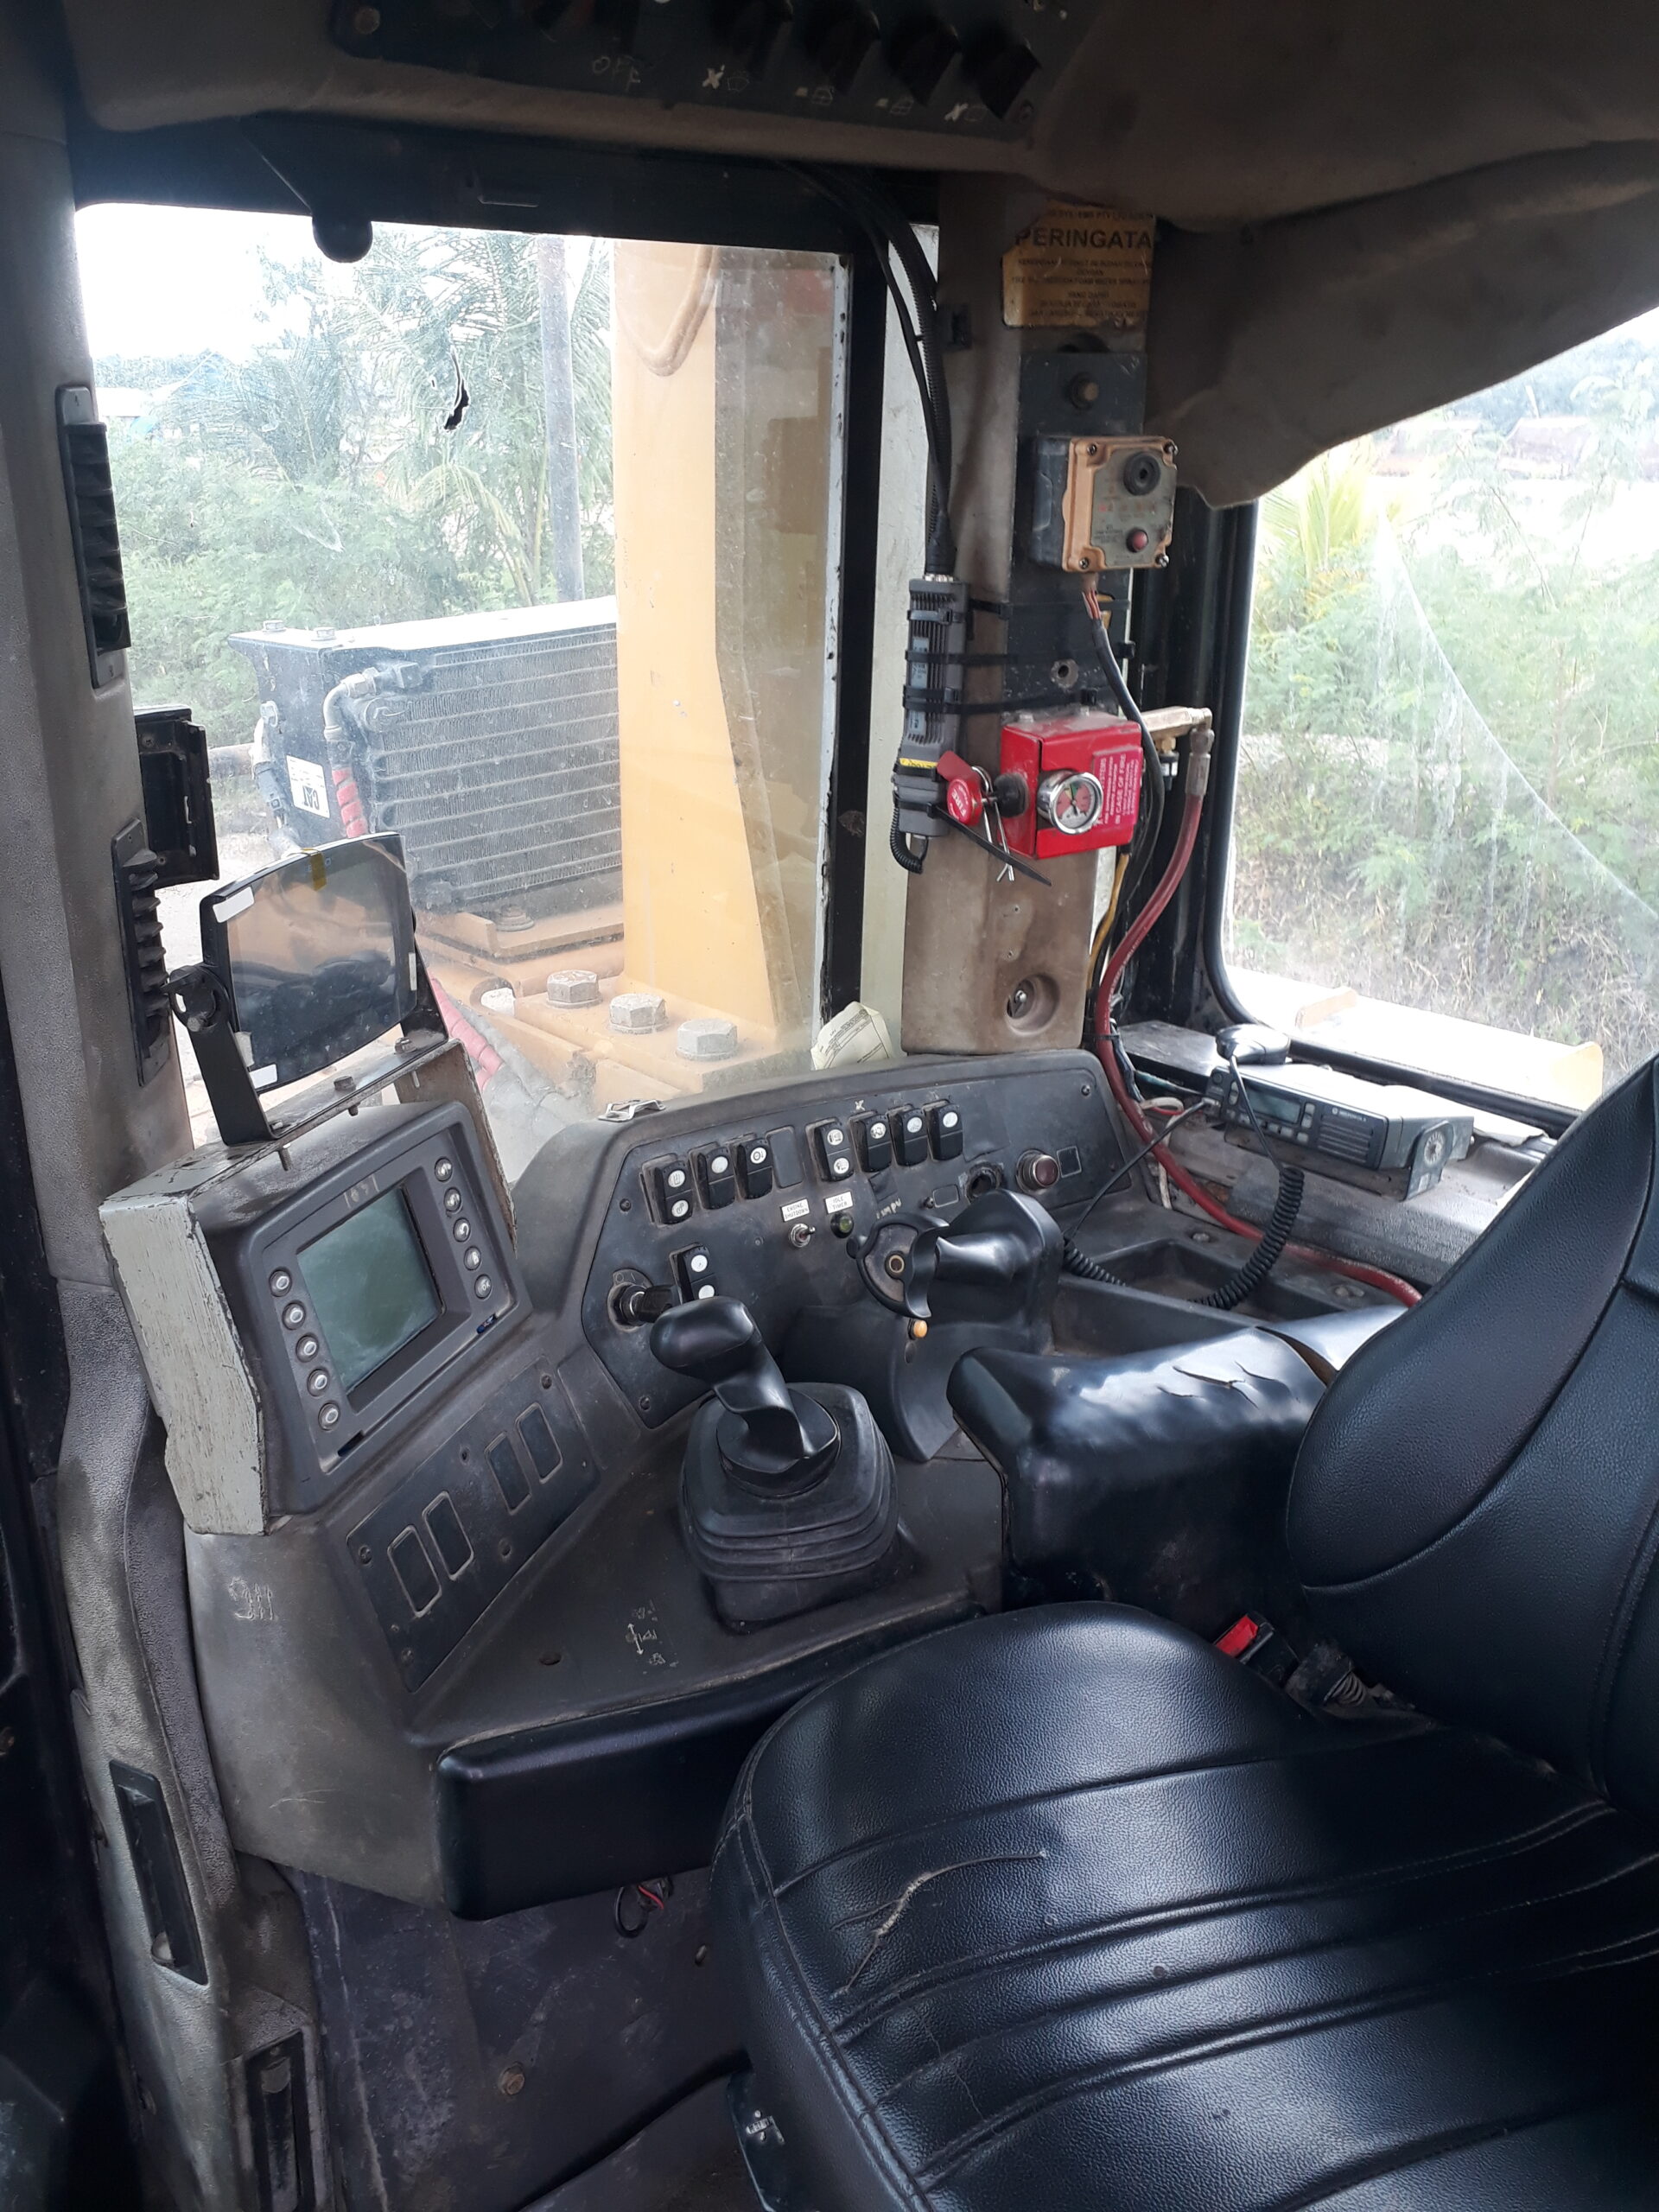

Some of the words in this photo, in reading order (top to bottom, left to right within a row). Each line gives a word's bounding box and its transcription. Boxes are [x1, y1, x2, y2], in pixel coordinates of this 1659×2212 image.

[1118, 775, 1123, 787] OF
[302, 786, 321, 810] CAT
[951, 787, 966, 817] FIRE
[786, 1203, 804, 1212] ENGINE
[832, 1202, 849, 1211] TIMER
[785, 1208, 809, 1220] SHUTDOWN
